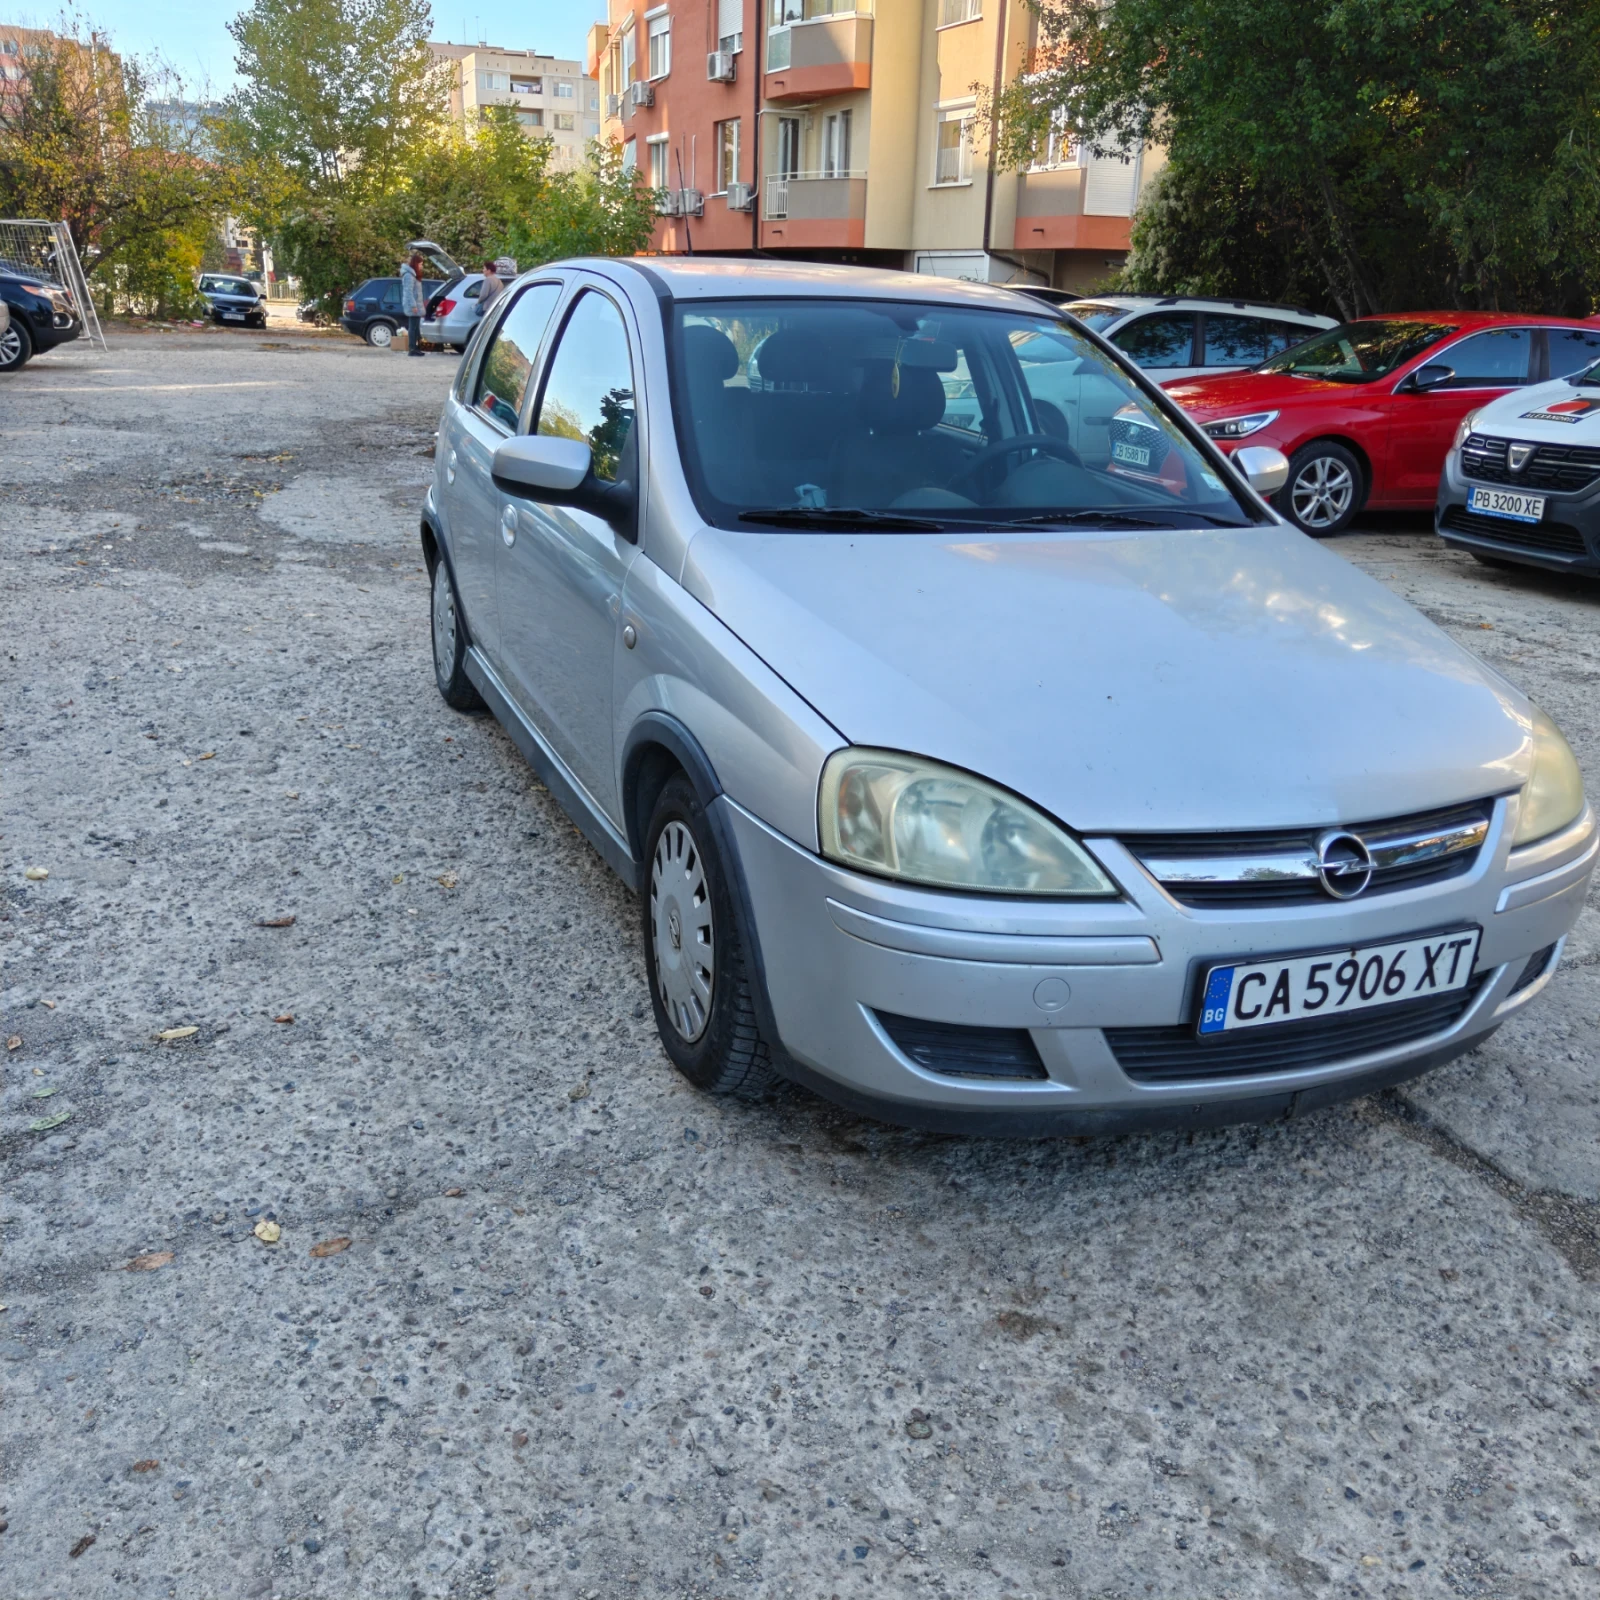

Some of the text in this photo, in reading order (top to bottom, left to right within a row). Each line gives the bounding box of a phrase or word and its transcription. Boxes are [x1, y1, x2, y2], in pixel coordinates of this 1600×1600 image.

[1474, 491, 1490, 508] PB
[1491, 493, 1522, 513] 3200
[1523, 498, 1542, 516] XE
[1234, 938, 1472, 1020] CA 5906 XT
[1204, 1007, 1225, 1024] BG
